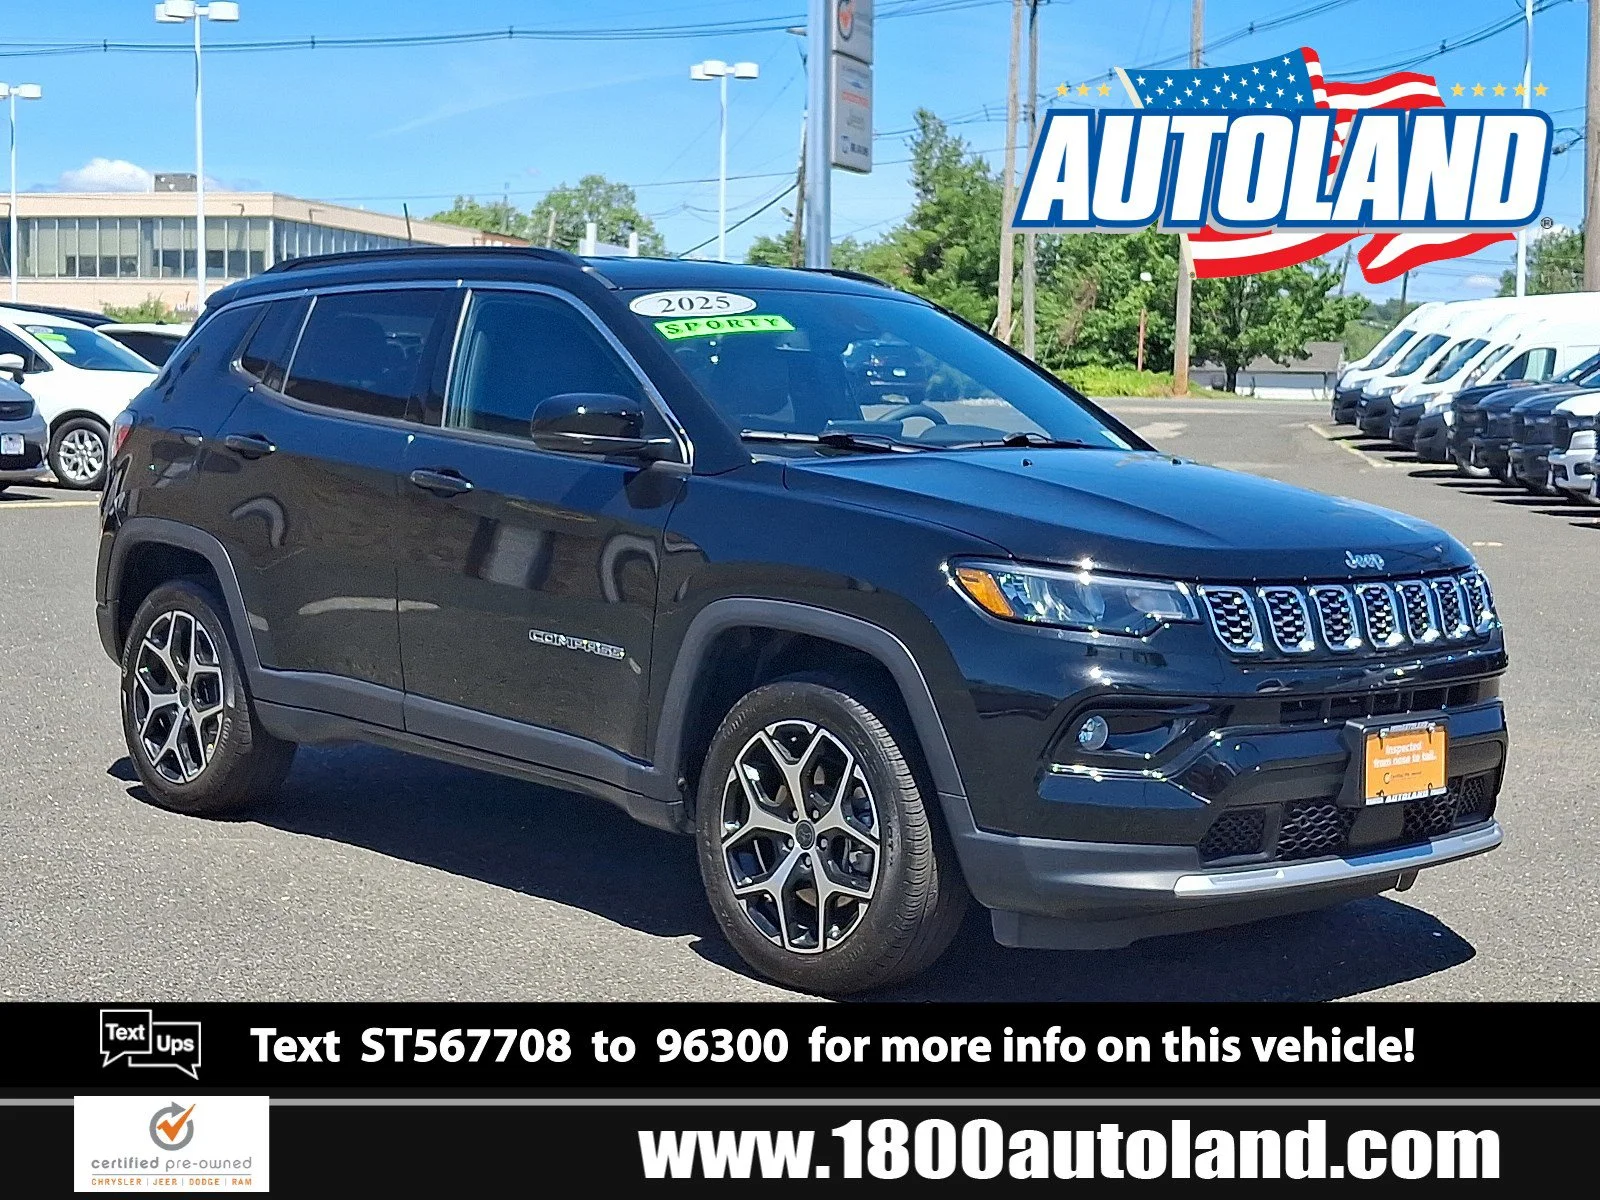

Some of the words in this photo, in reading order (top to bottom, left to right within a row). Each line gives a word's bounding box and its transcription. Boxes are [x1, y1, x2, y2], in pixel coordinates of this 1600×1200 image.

[657, 296, 731, 313] 2025
[664, 317, 779, 335] SPORTY
[1345, 550, 1385, 571] Jeep
[529, 629, 625, 660] COMPASS
